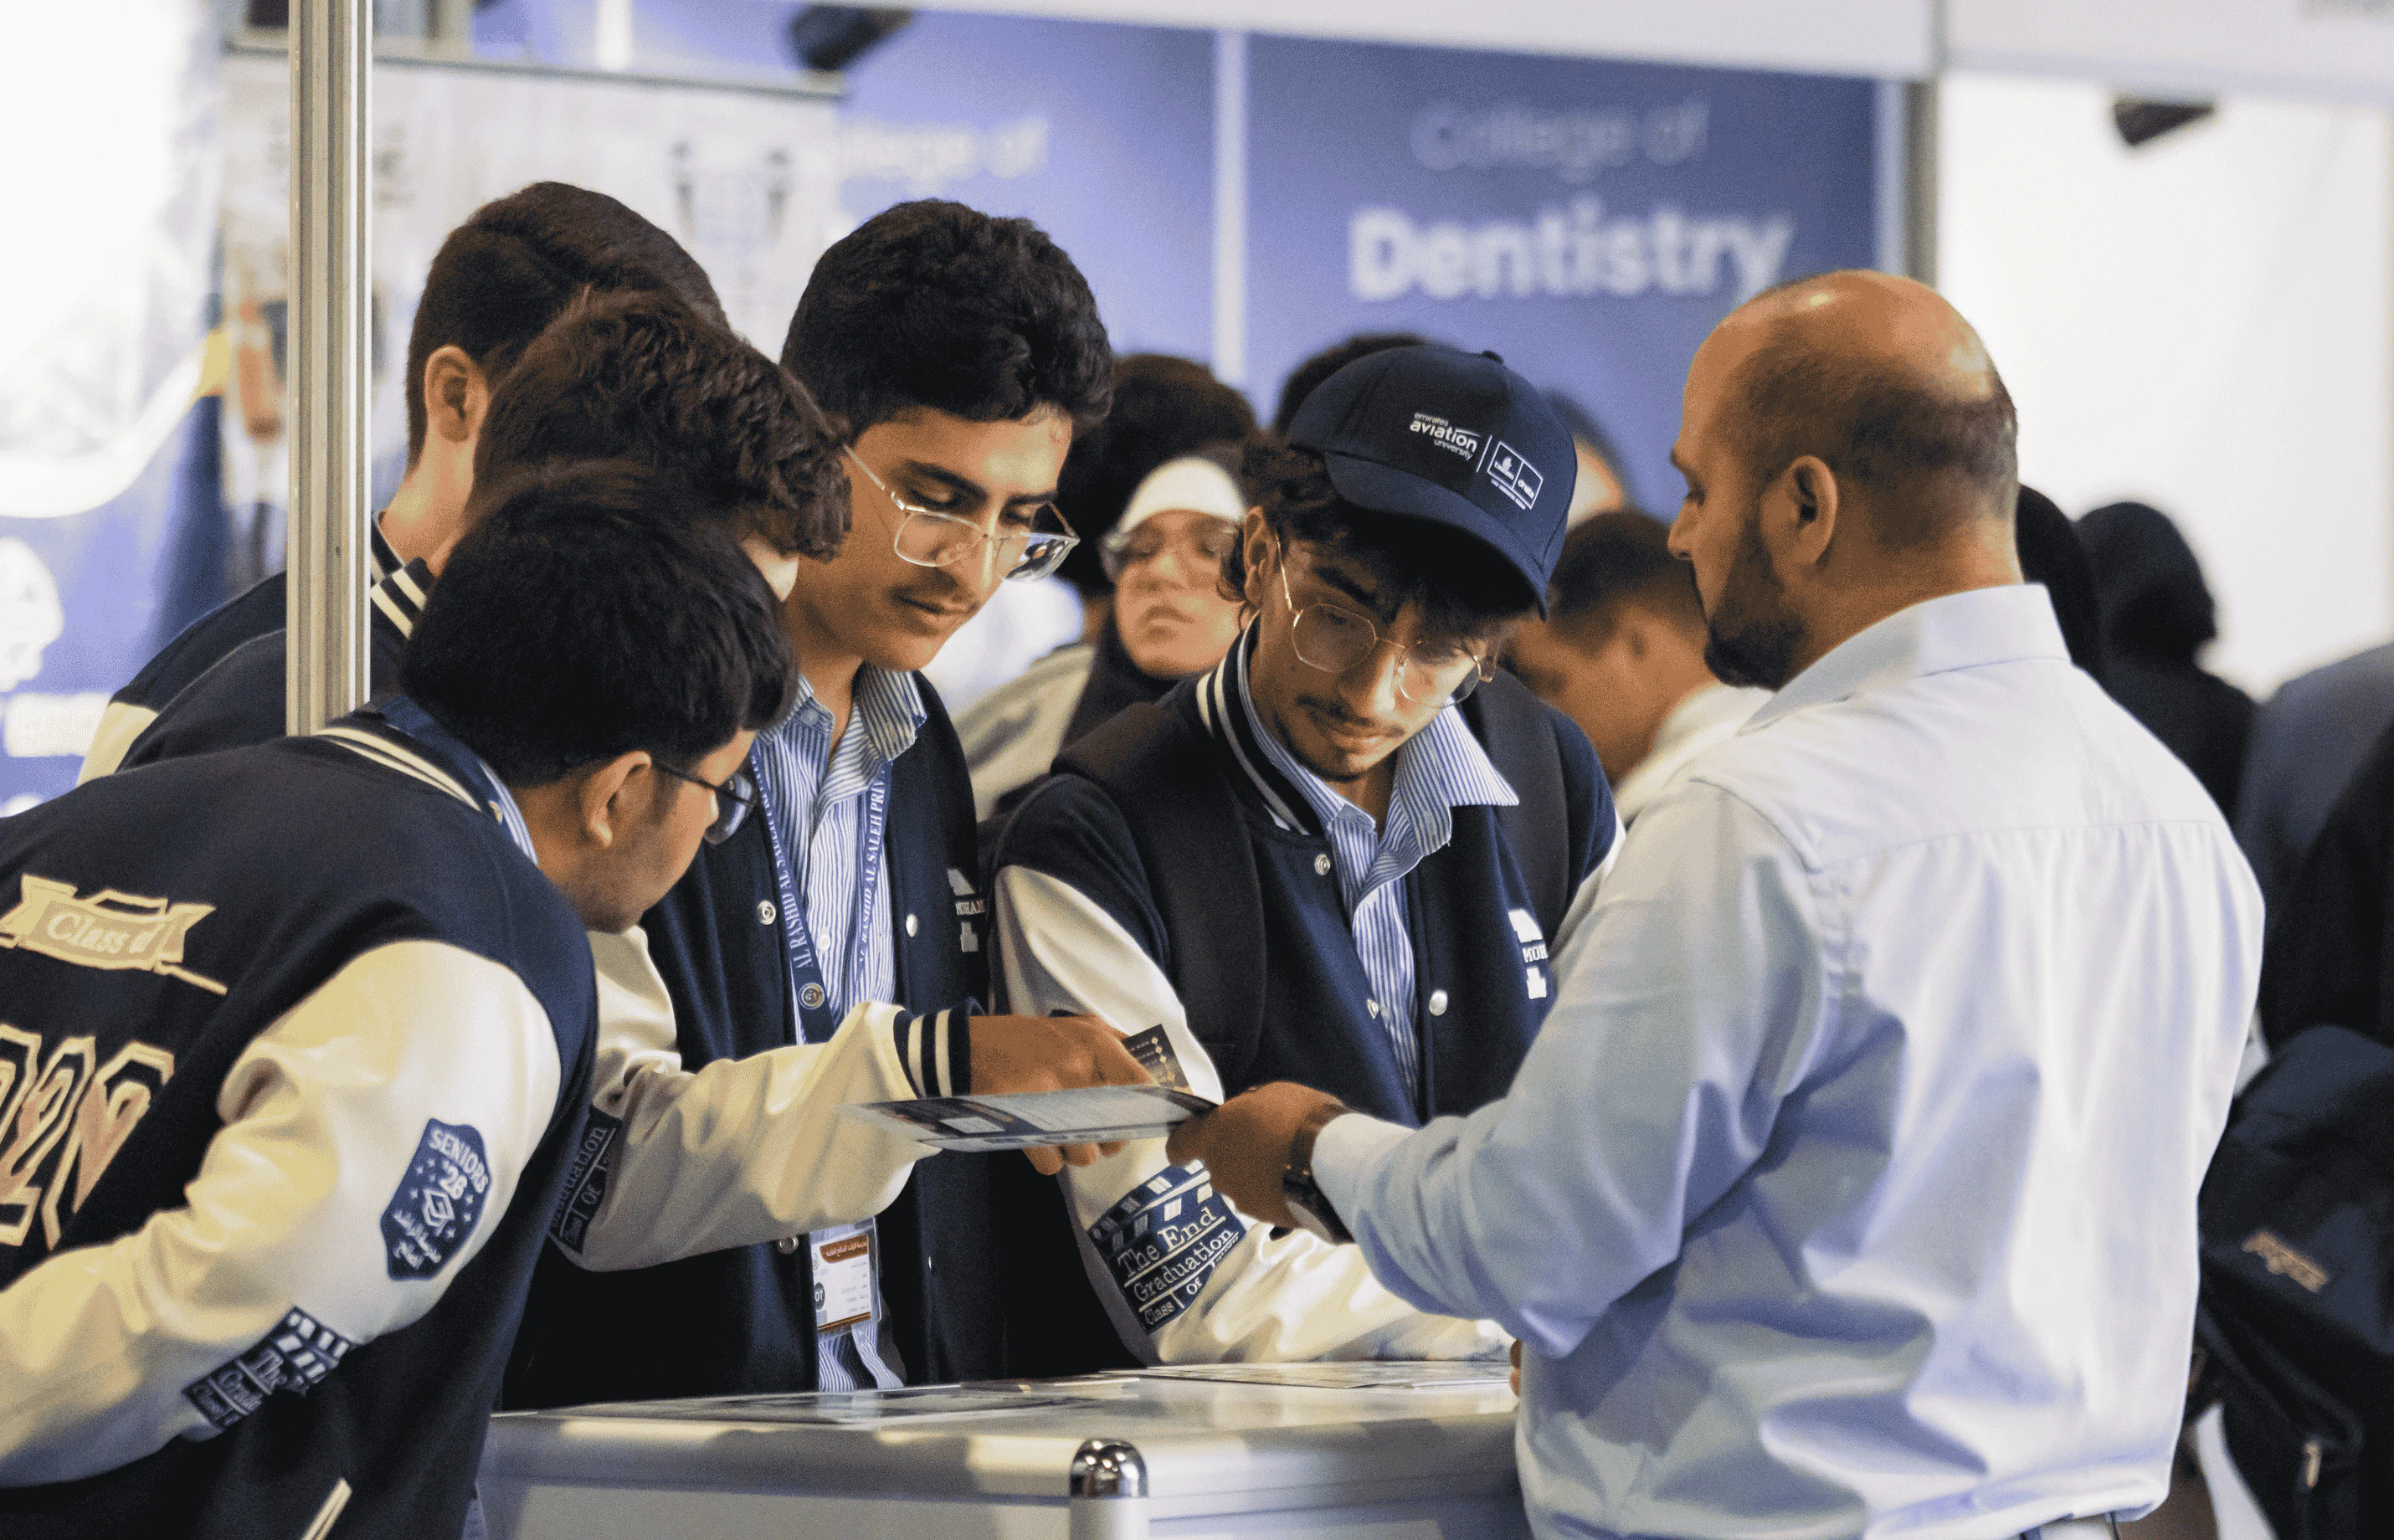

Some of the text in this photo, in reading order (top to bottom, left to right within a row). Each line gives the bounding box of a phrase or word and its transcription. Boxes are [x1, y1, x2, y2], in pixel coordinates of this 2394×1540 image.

[1349, 196, 1793, 308] Dentistry
[1410, 420, 1477, 453] aviation
[1415, 413, 1449, 427] emirates
[1433, 439, 1472, 461] university
[867, 814, 882, 864] SALEH
[778, 870, 792, 890] AL
[866, 867, 876, 884] AL
[48, 912, 129, 954] Class
[782, 893, 807, 949] RASHID
[796, 949, 814, 968] AL
[428, 1127, 489, 1194] SENIORS
[1117, 1245, 1159, 1278] The
[1158, 1206, 1217, 1253] End
[1133, 1229, 1234, 1301] Graduation
[1144, 1277, 1203, 1325] Class Of
